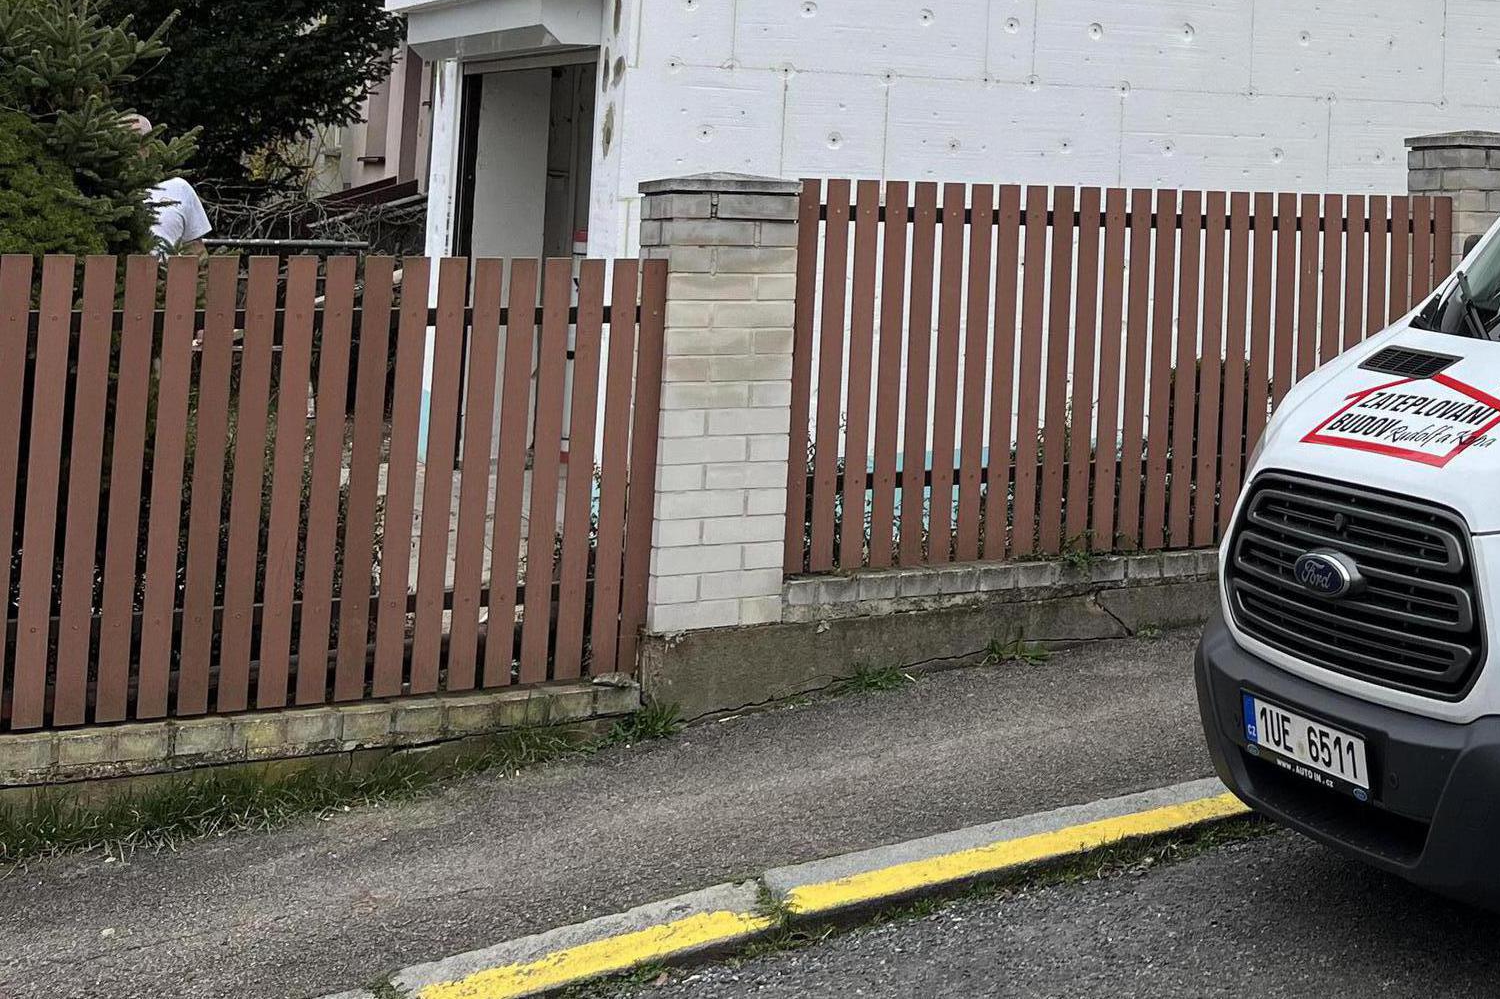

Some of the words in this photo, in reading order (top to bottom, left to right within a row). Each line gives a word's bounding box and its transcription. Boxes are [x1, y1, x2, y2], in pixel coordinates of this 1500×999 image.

[1326, 413, 1403, 439] BUDOV
[1301, 559, 1333, 590] Ford
[1247, 724, 1257, 737] CZ
[1260, 706, 1294, 754] 1UE
[1307, 725, 1359, 780] 6511
